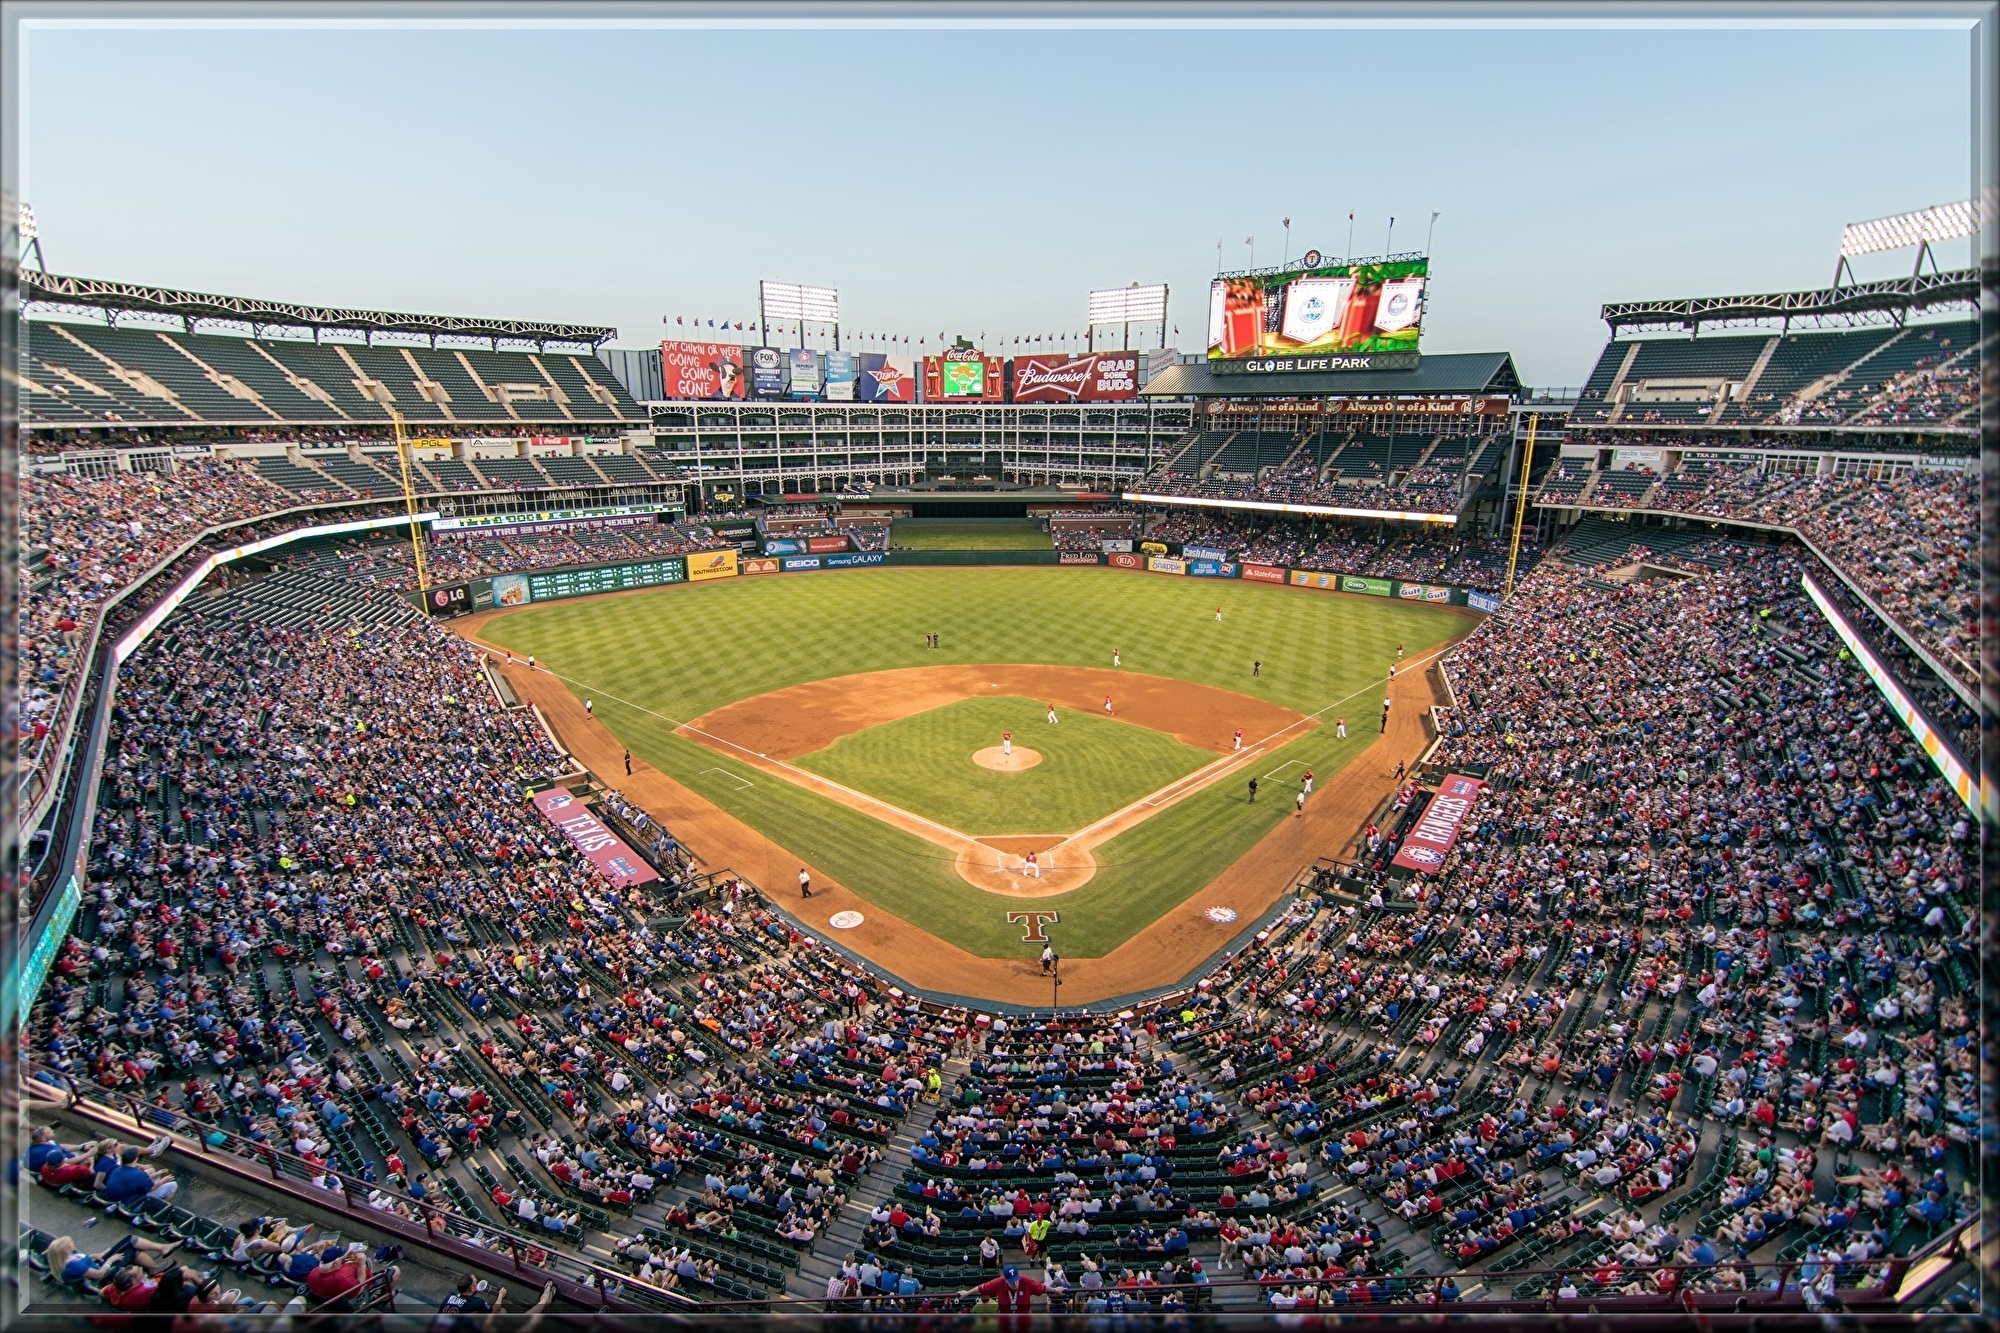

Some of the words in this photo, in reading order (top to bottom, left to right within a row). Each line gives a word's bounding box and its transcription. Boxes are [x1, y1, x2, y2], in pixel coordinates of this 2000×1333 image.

[664, 341, 678, 352] EAT
[680, 342, 704, 354] CHIKIN
[708, 344, 718, 356] OR
[720, 346, 741, 358] WEER
[669, 354, 700, 367] GOING
[1097, 360, 1135, 372] GRAB
[1246, 360, 1294, 372] GLOBE
[1297, 359, 1328, 370] LIFE
[1332, 357, 1370, 369] PARK
[682, 366, 714, 381] GOING
[876, 370, 900, 381] Ozarka
[1017, 368, 1091, 385] Budweiser
[678, 380, 712, 396] GONE
[1097, 379, 1134, 391] BUDS
[1227, 402, 1259, 412] Always
[1278, 402, 1288, 411] of
[1295, 402, 1318, 411] Kind
[1347, 402, 1383, 412] Always
[1407, 402, 1418, 411] of
[1427, 402, 1454, 411] Kind
[1929, 456, 1945, 465] MLB
[536, 523, 567, 532] NEXEN
[605, 518, 633, 526] NEXEN
[494, 527, 517, 536] TIRE
[786, 560, 819, 568] GEICO
[852, 555, 882, 563] GALAXY
[693, 566, 733, 575] SOUTHWEST.COM
[1152, 560, 1181, 571] Snapple
[450, 589, 464, 601] LG
[1414, 795, 1468, 844] RANGERS
[560, 813, 618, 852] TEXAS
[1007, 911, 1058, 942] T
[447, 1295, 466, 1307] YOUNG
